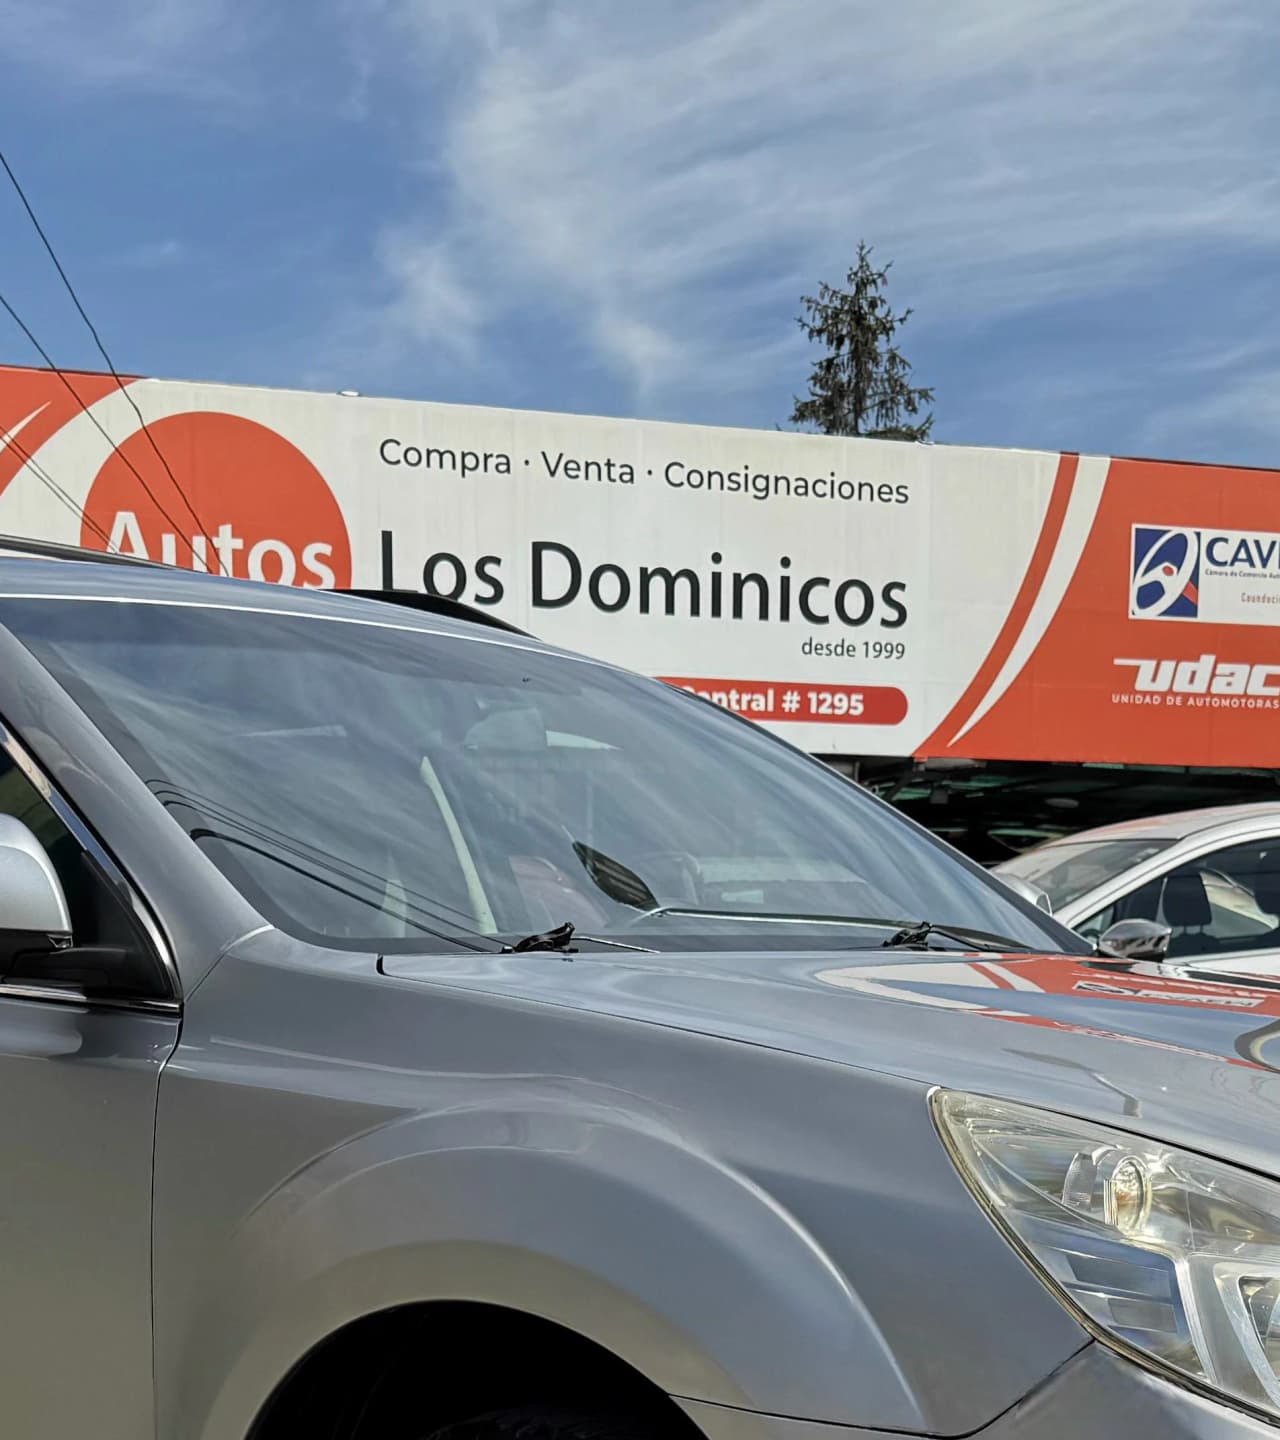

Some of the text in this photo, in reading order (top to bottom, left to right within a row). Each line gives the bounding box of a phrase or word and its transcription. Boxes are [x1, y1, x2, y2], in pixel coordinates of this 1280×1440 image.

[379, 438, 910, 504] Compra Venta Consignaciones
[106, 511, 909, 629] Autos Los Dominicos
[801, 636, 906, 661] desde 1999
[681, 686, 864, 716] ntral # 1295
[1111, 693, 1162, 706] UNIDAD
[1166, 696, 1183, 706] DE
[1186, 697, 1280, 710] AUTOMOTORAS
